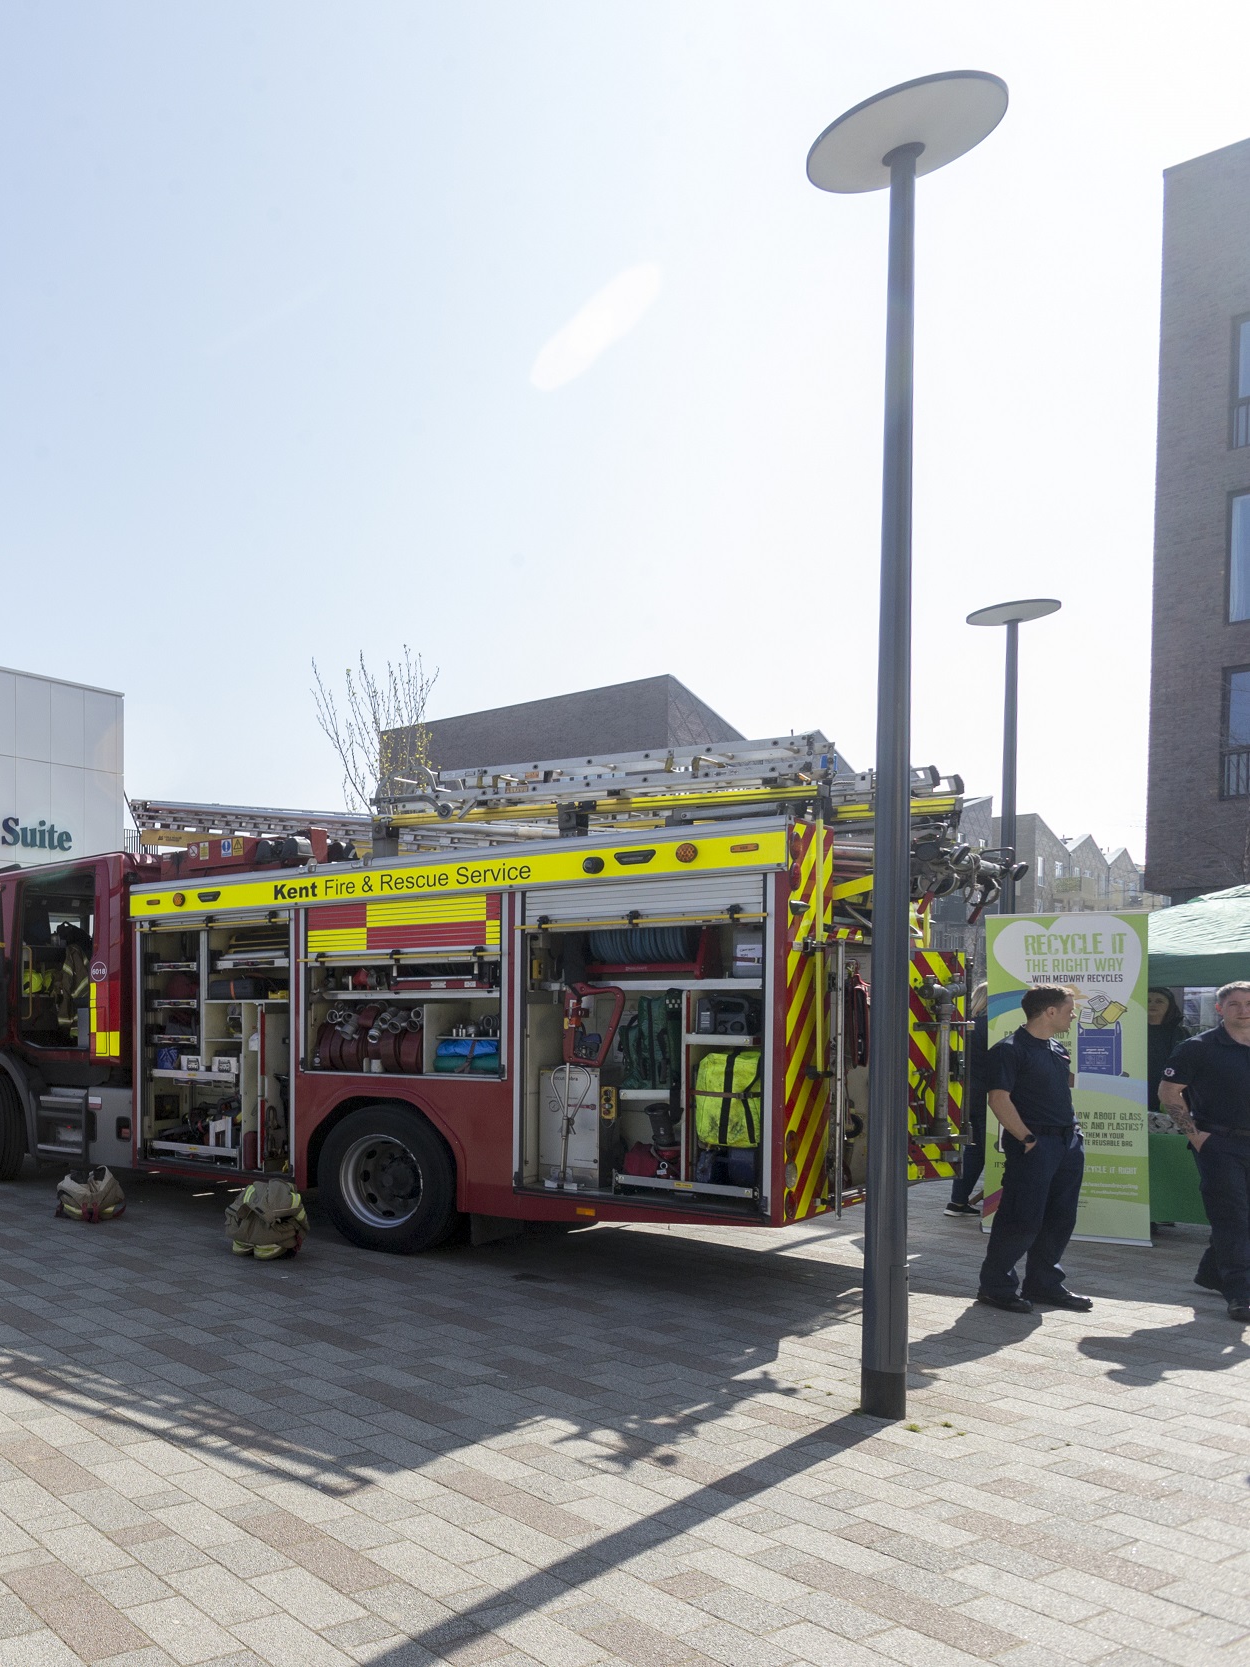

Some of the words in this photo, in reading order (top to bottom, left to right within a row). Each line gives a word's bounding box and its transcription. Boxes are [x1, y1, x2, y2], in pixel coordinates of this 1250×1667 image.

[1, 817, 73, 851] Suite
[273, 881, 317, 900] Kent
[324, 878, 355, 896] Fire
[361, 875, 374, 893] &
[380, 869, 449, 891] Rescue
[456, 863, 532, 885] Service
[1023, 932, 1105, 956] RECYCLE
[1111, 932, 1127, 955] IT
[1025, 958, 1049, 973] THE
[1052, 958, 1091, 973] RIGHT
[1093, 957, 1124, 972] WAY
[1052, 974, 1085, 983] MEDWAY
[1087, 973, 1124, 983] RECYCLES
[1076, 1111, 1090, 1120] OW
[1093, 1112, 1117, 1120] ABOUT
[1119, 1112, 1144, 1122] GLASS,
[1090, 1121, 1105, 1130] AND
[1107, 1122, 1144, 1131] PLASTICS?
[1085, 1131, 1101, 1139] THEM
[1091, 1139, 1120, 1147] REUSABLE
[1084, 1165, 1107, 1173] ECYCLE
